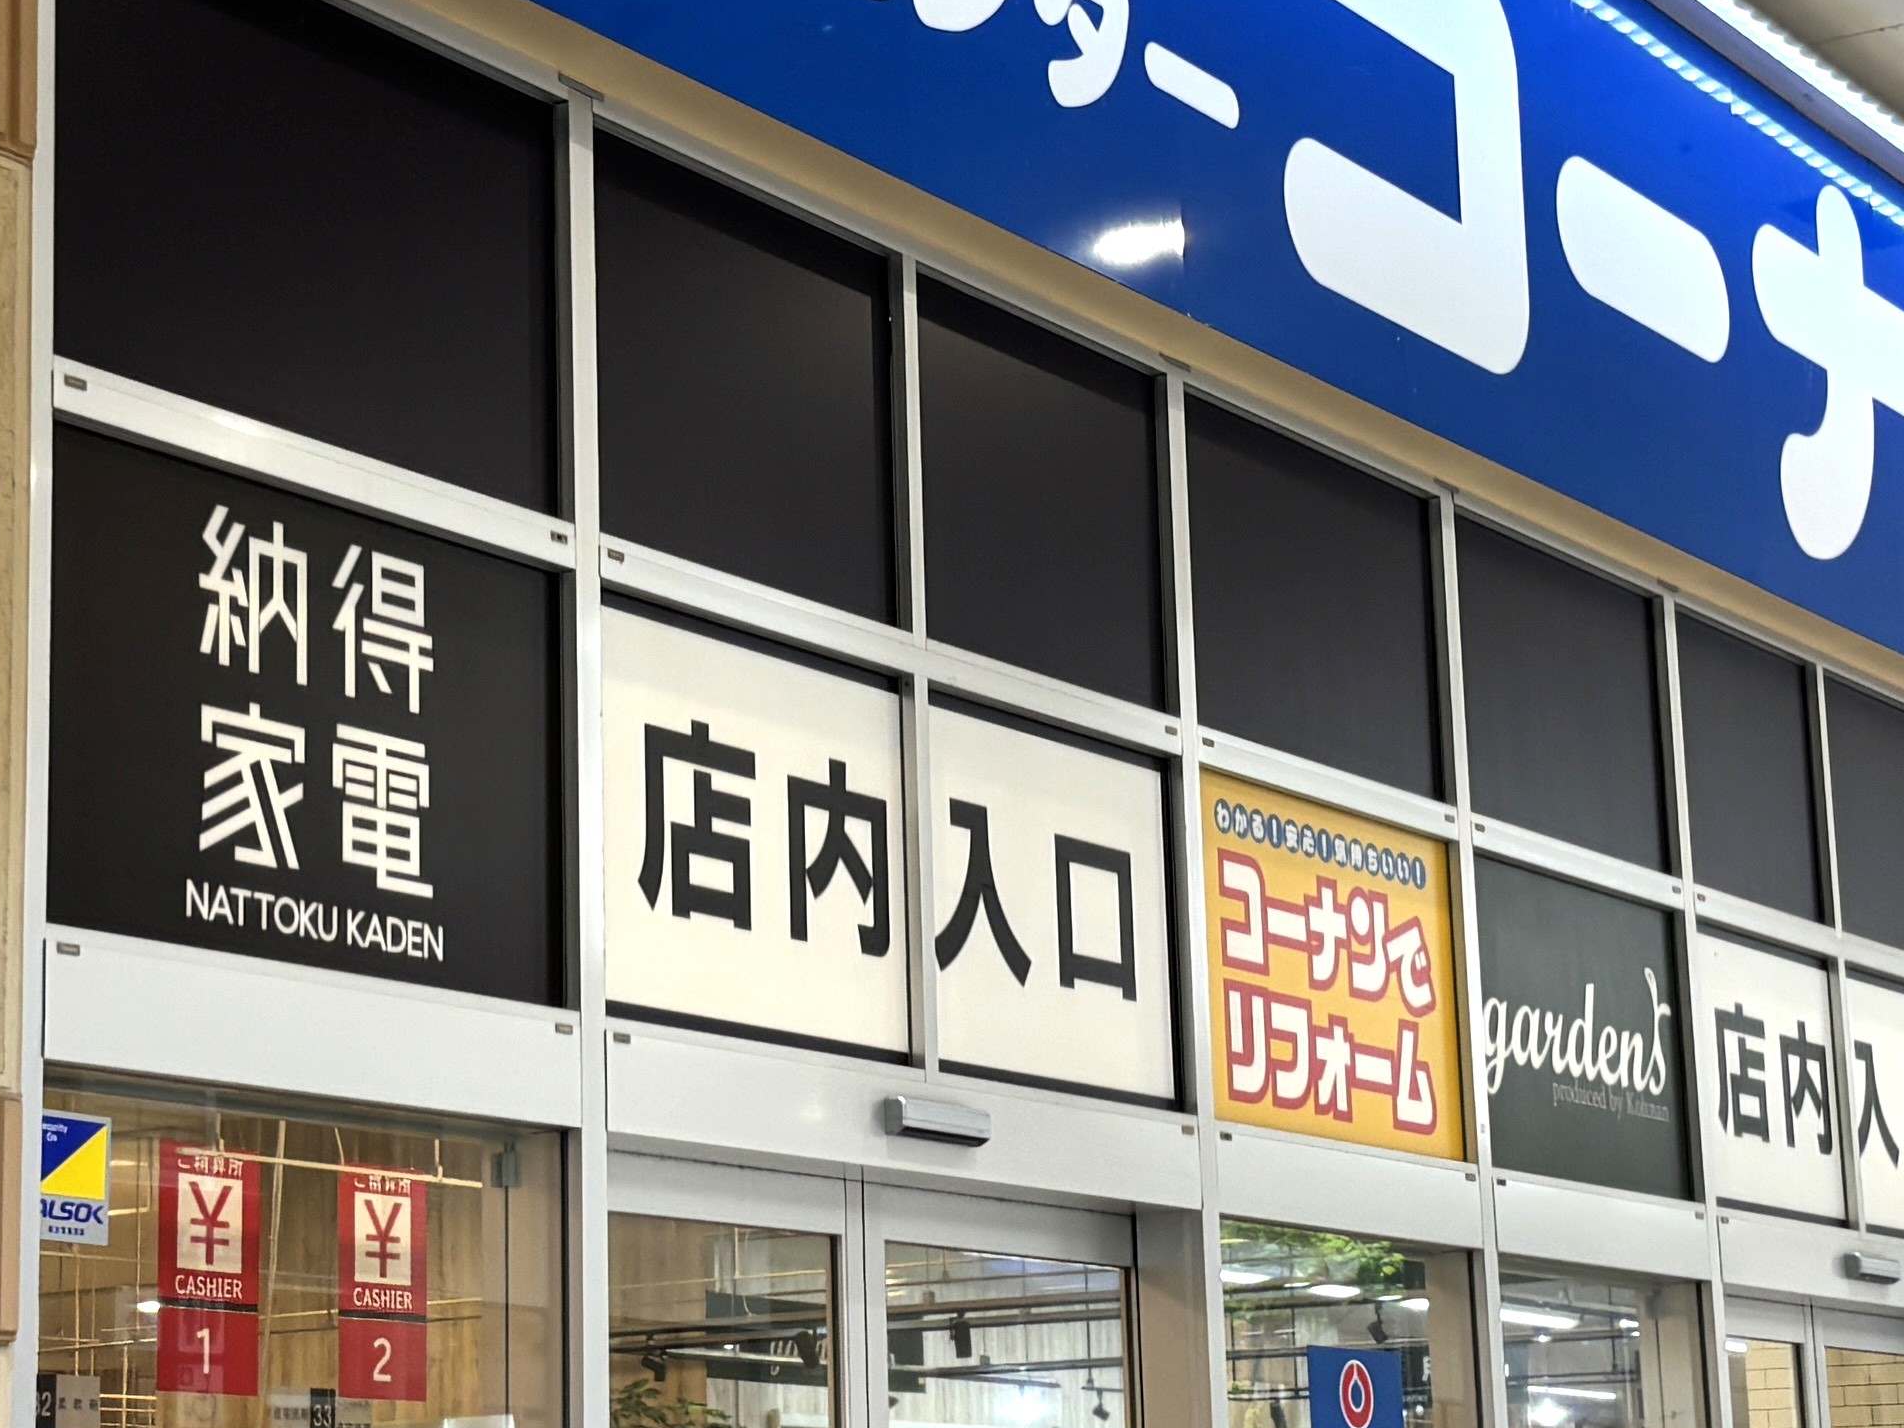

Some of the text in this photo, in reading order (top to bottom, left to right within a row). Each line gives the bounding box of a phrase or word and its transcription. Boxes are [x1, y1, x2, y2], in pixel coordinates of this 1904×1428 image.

[199, 505, 434, 711] 納得
[199, 702, 434, 897] 家電
[636, 721, 1138, 1002] 店内入口
[185, 878, 444, 961] NATTOKU KADEN
[1219, 850, 1436, 1015] コーナンで
[1224, 978, 1436, 1134] リフォーム
[1553, 1083, 1607, 1109] produced
[1610, 1085, 1623, 1120] by
[175, 1275, 243, 1299] CASHIER
[353, 1287, 412, 1311] CASHIER
[196, 1328, 211, 1374] 1
[372, 1337, 392, 1383] 2
[312, 1407, 333, 1428] 33
